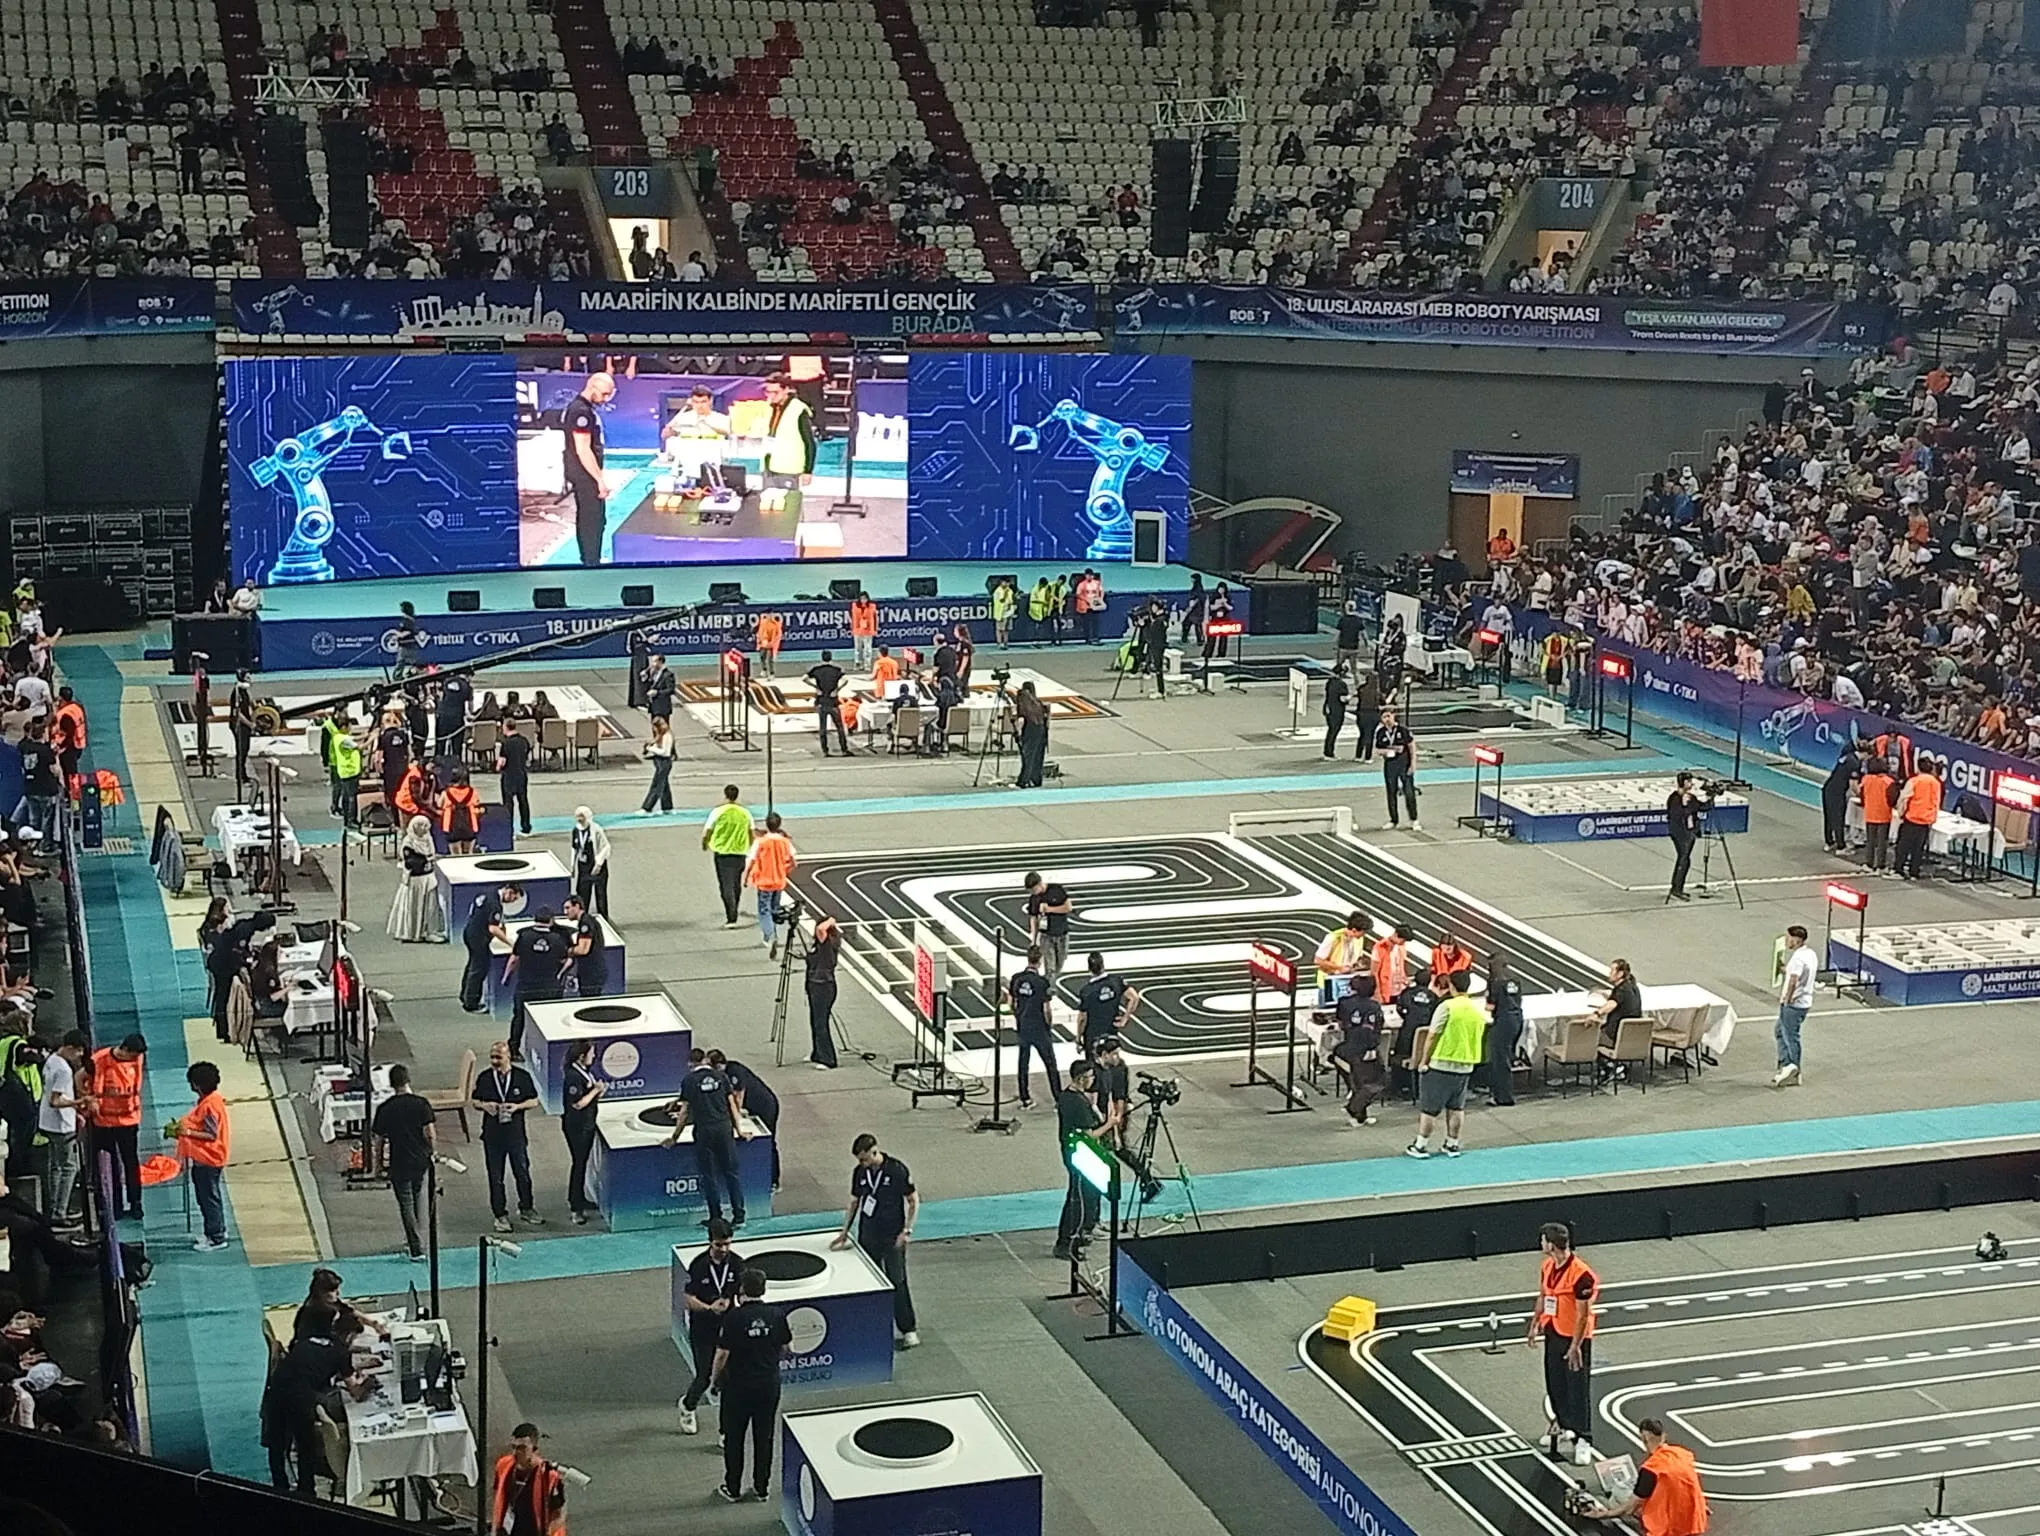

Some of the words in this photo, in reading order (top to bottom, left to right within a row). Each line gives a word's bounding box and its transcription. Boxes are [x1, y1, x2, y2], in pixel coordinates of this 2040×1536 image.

[614, 170, 648, 196] 203
[1560, 183, 1594, 208] 204
[581, 288, 684, 311] MAARİFİN
[687, 288, 785, 311] KALBİNDE
[789, 288, 888, 311] MARİFETLİ
[892, 288, 976, 316] GENÇLİK
[1287, 298, 1305, 312] 18.
[1307, 298, 1418, 315] ULUSLARARASI
[1419, 303, 1452, 317] MEB
[1455, 304, 1512, 319] ROBOT
[1512, 306, 1600, 324] YARIŞMASI
[892, 315, 975, 333] BURADA
[1501, 325, 1595, 338] COMPETITION
[546, 620, 568, 636] 18.
[698, 613, 734, 630] MEB
[736, 612, 794, 629] ROOT
[798, 1354, 833, 1369] SUMO
[1166, 1317, 1215, 1381] OTONOM
[1215, 1366, 1249, 1419] ARAÇ
[1249, 1396, 1321, 1487] KATEGORİSİ
